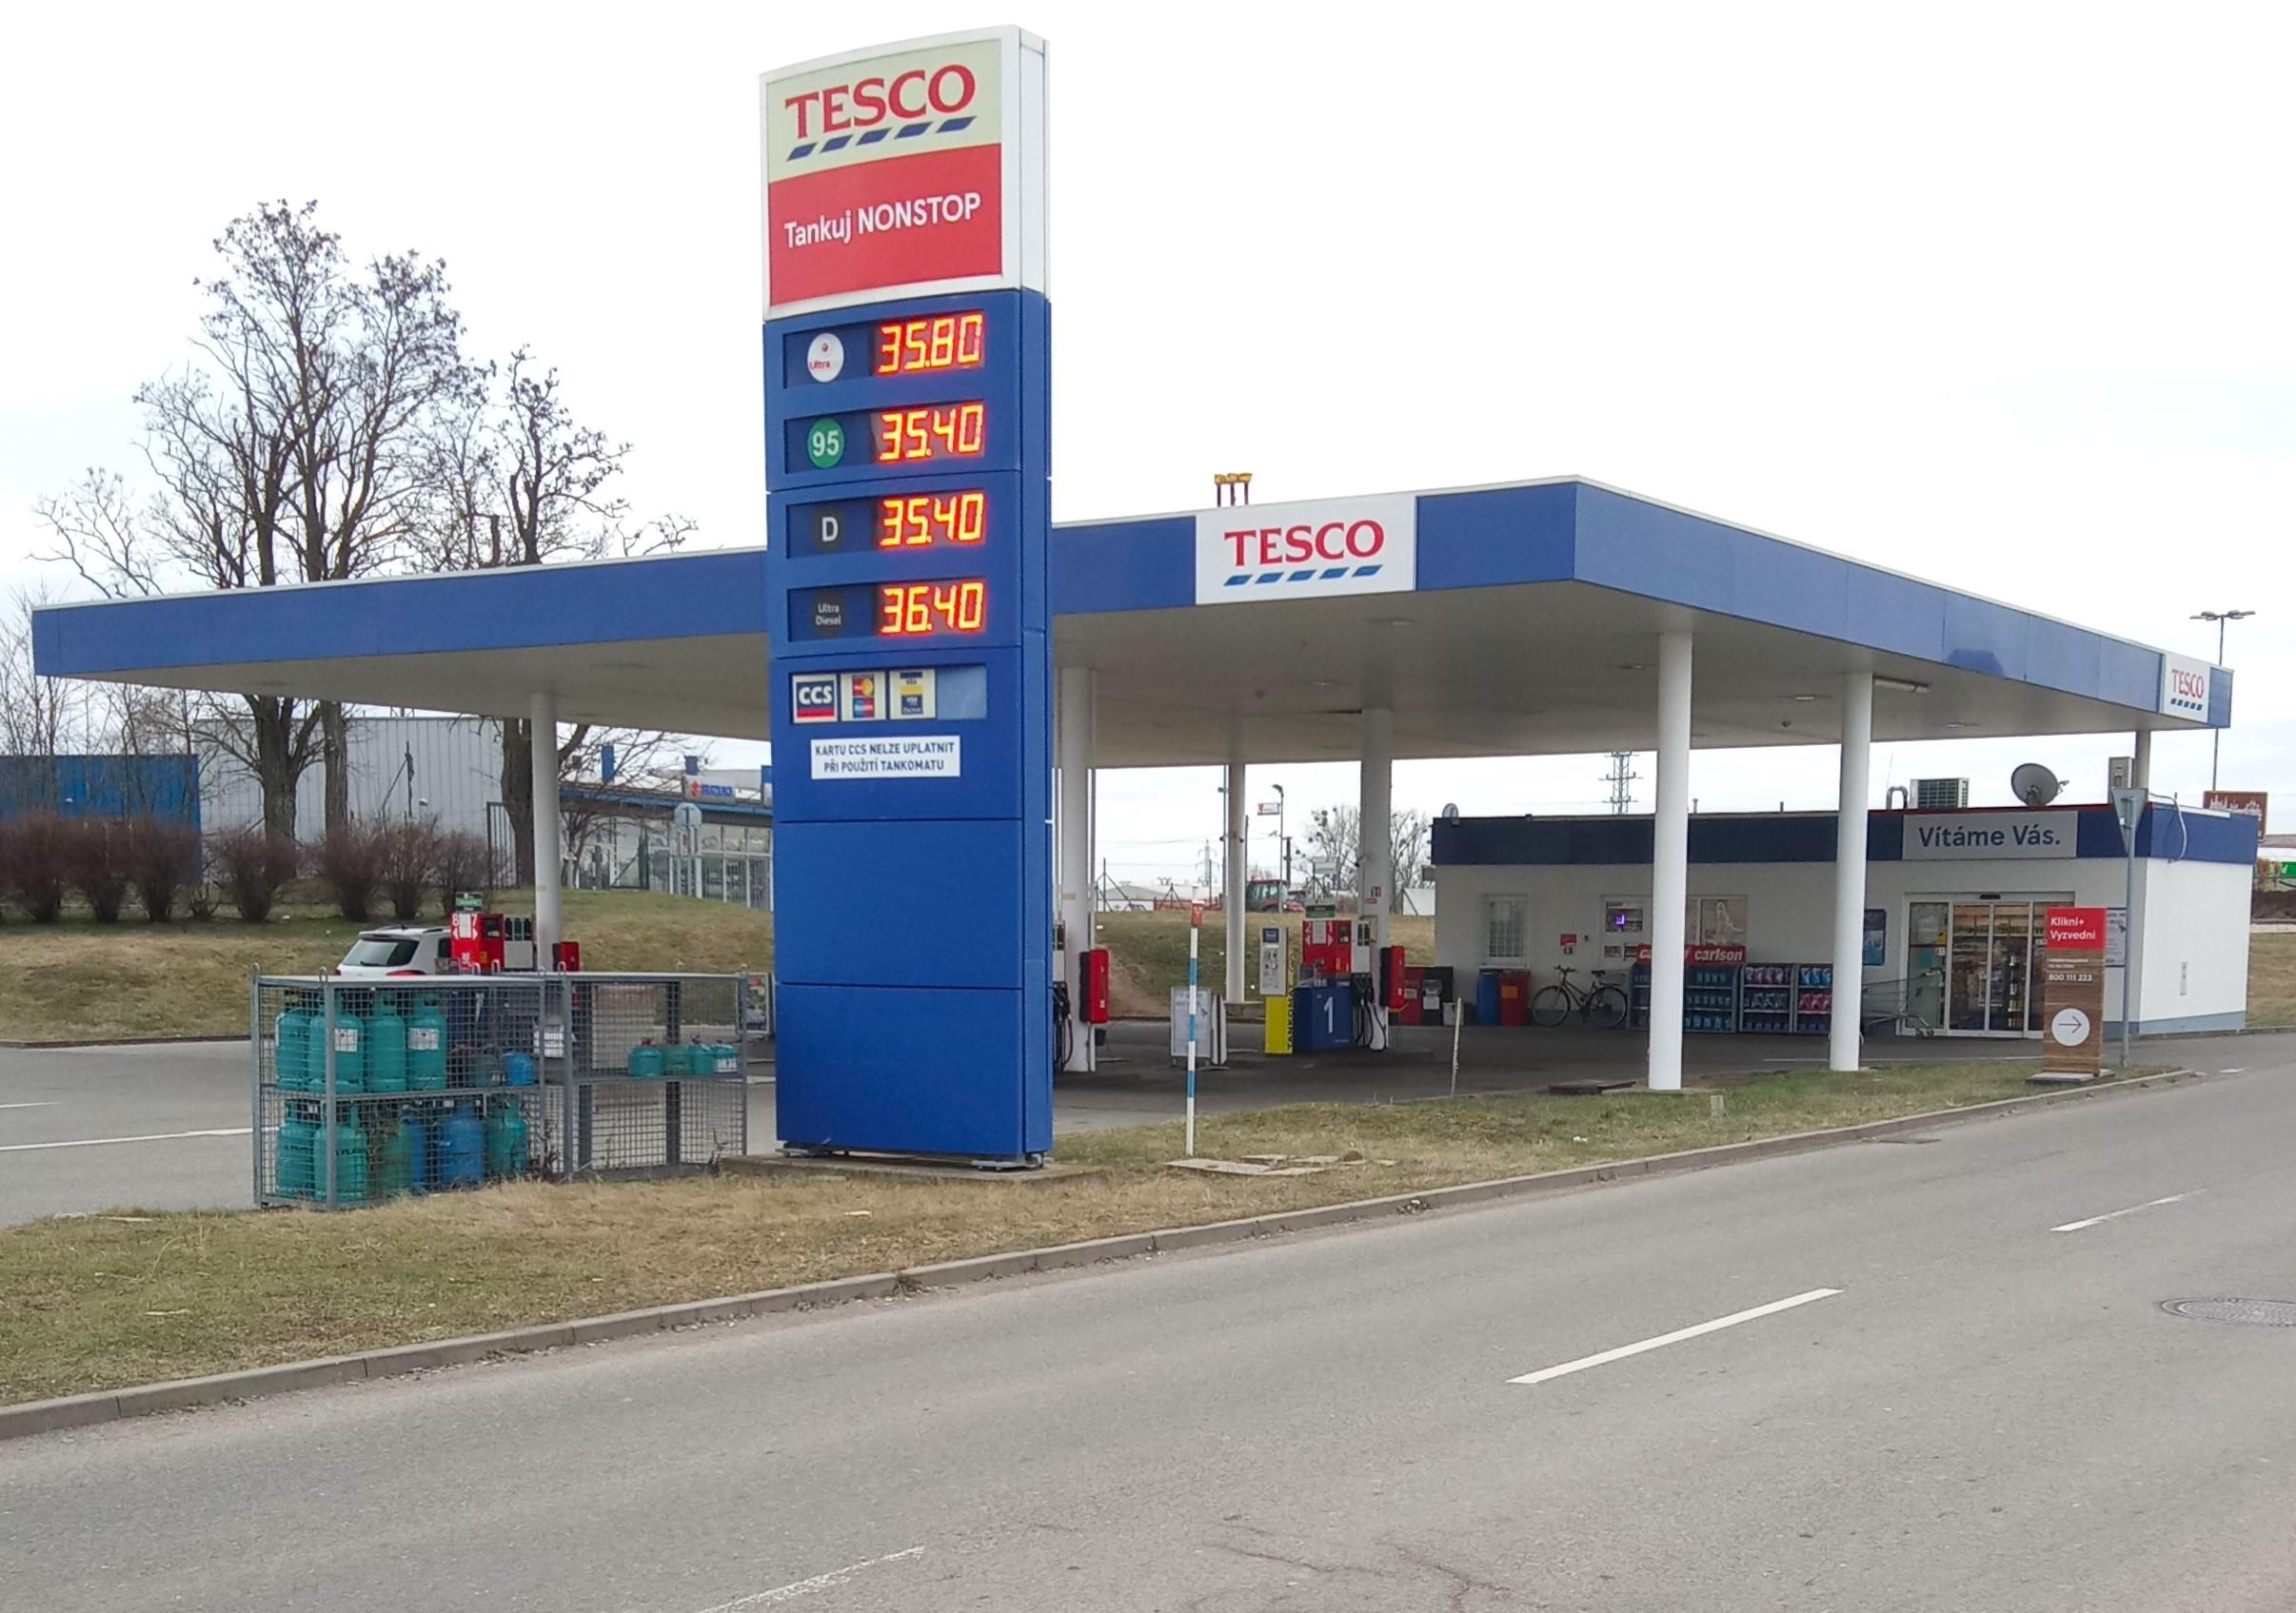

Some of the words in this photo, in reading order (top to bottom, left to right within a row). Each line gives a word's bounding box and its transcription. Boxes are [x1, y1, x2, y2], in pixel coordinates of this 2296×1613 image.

[784, 64, 976, 139] TESCO
[783, 209, 852, 248] Tankuj
[858, 192, 981, 234] NONSTOP
[878, 313, 983, 374] 35.80
[812, 430, 840, 458] 95
[879, 403, 984, 461] 35.40
[821, 517, 839, 542] D
[879, 492, 985, 547] 35.40
[1224, 520, 1385, 567] TESCO
[816, 615, 841, 625] Diesel
[818, 603, 840, 613] Ultra
[881, 581, 985, 635] 36.40
[799, 685, 833, 704] CCS
[2171, 668, 2205, 698] TESCO
[815, 744, 846, 757] KARTU
[848, 743, 867, 756] CCS
[869, 743, 901, 755] NELZE
[903, 742, 955, 754] UPLATNIT
[823, 758, 840, 773] PŘI
[841, 757, 879, 772] POUŽITÍ
[881, 759, 944, 772] TANKOMATU
[1919, 826, 2005, 848] Vítáme
[2012, 823, 2061, 846] Vás.
[452, 914, 459, 927] 8
[471, 914, 478, 927] 7
[2049, 930, 2096, 942] Vyzvedni
[1694, 948, 1743, 961] carlson
[1324, 996, 1334, 1034] 1
